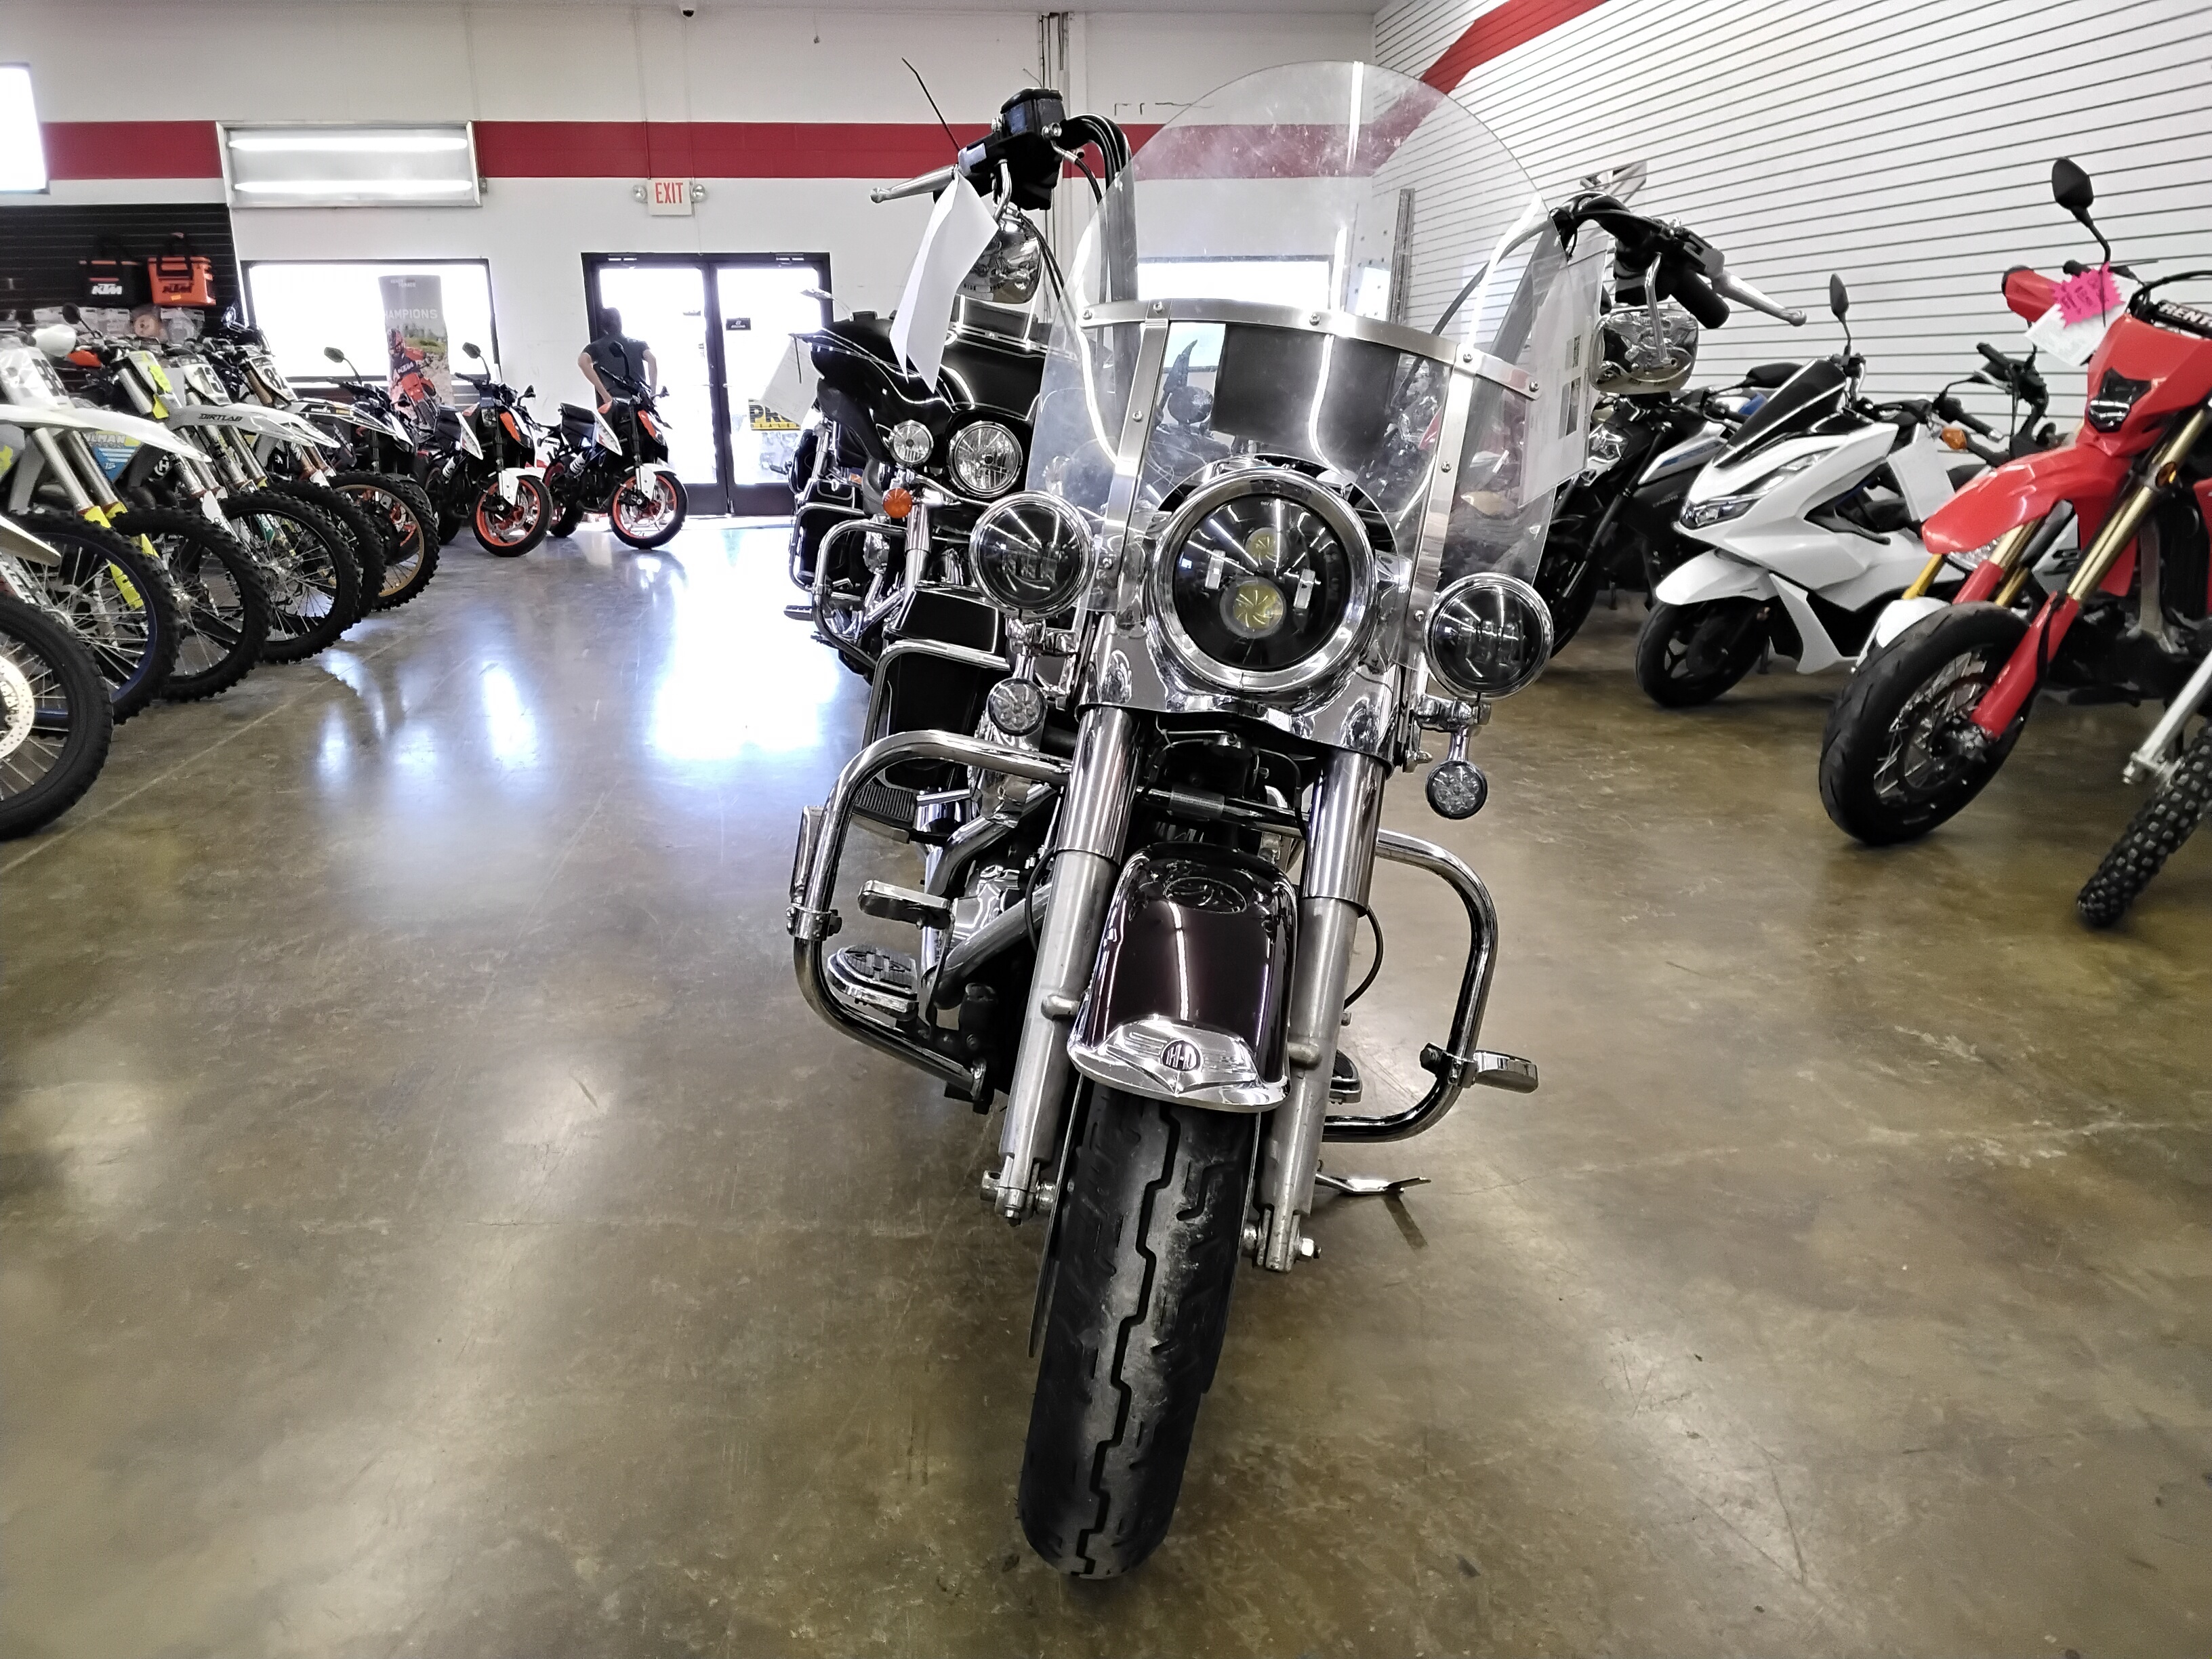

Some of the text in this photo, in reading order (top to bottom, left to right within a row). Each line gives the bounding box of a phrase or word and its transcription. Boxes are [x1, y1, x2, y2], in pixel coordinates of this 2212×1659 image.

[655, 182, 683, 204] EXIT
[91, 283, 123, 295] KTM
[2159, 303, 2212, 327] RENT
[199, 413, 243, 422] DIRTLAB
[748, 405, 794, 423] PR
